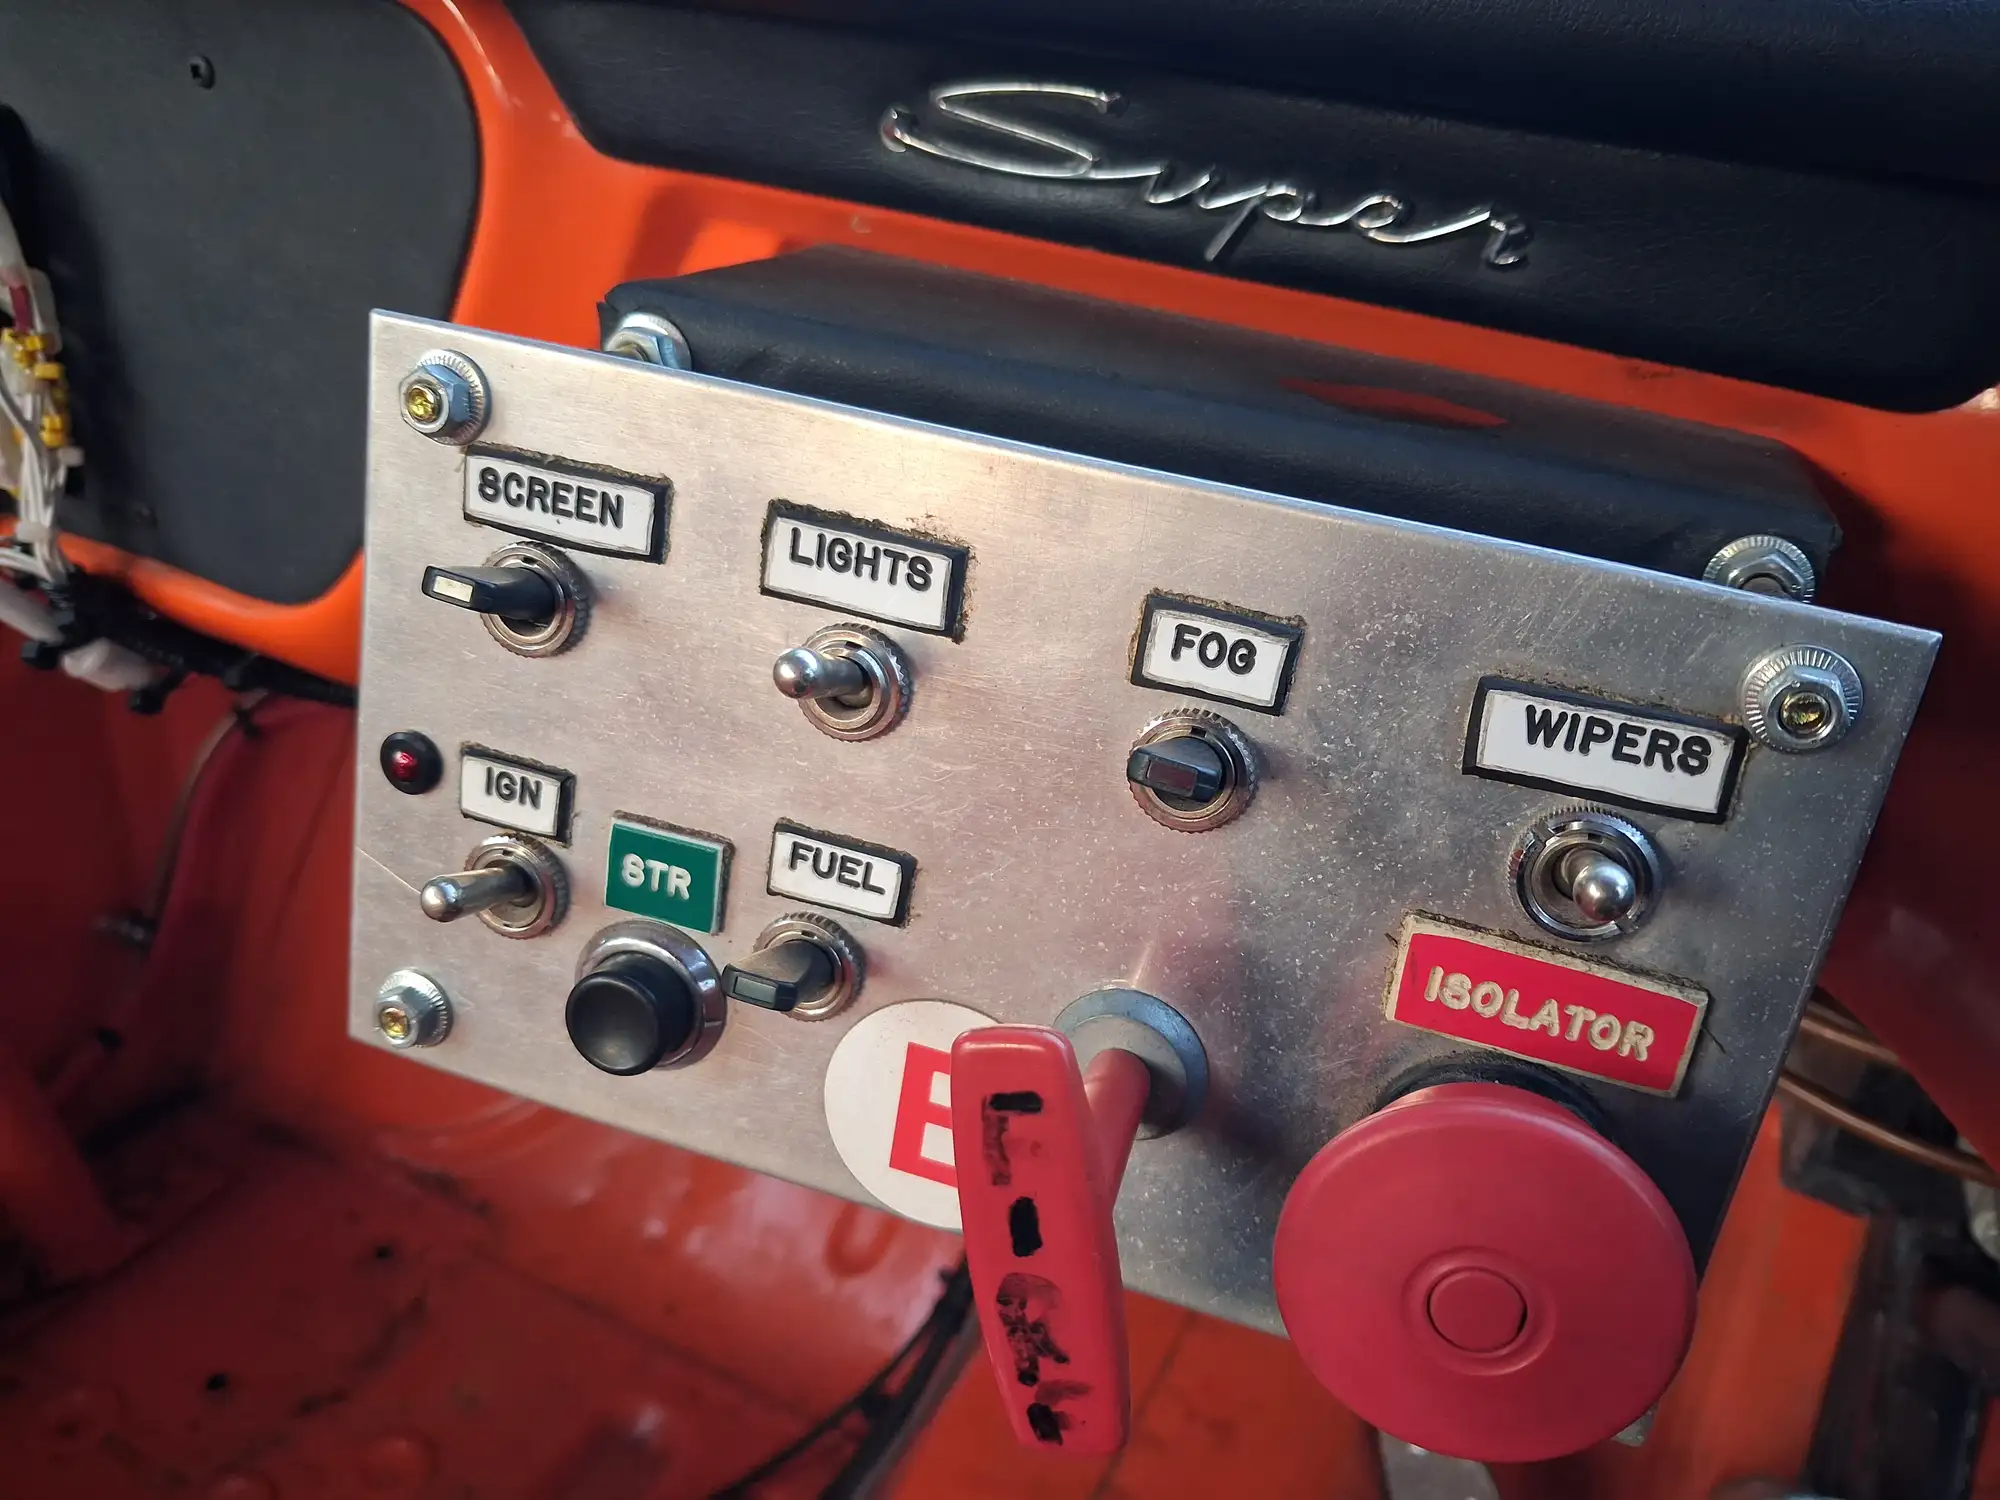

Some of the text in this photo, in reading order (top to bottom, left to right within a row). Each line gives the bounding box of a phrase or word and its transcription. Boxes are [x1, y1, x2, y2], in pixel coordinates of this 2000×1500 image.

[880, 82, 1527, 265] Super
[478, 466, 625, 529] SCREEN
[789, 527, 933, 592] LIGHTS
[1170, 623, 1257, 674] FOG
[1525, 705, 1713, 775] WIPERS
[484, 766, 542, 810] IGN
[621, 852, 692, 900] STR
[788, 839, 886, 896] FUEL
[1423, 965, 1655, 1062] ISOLATOR
